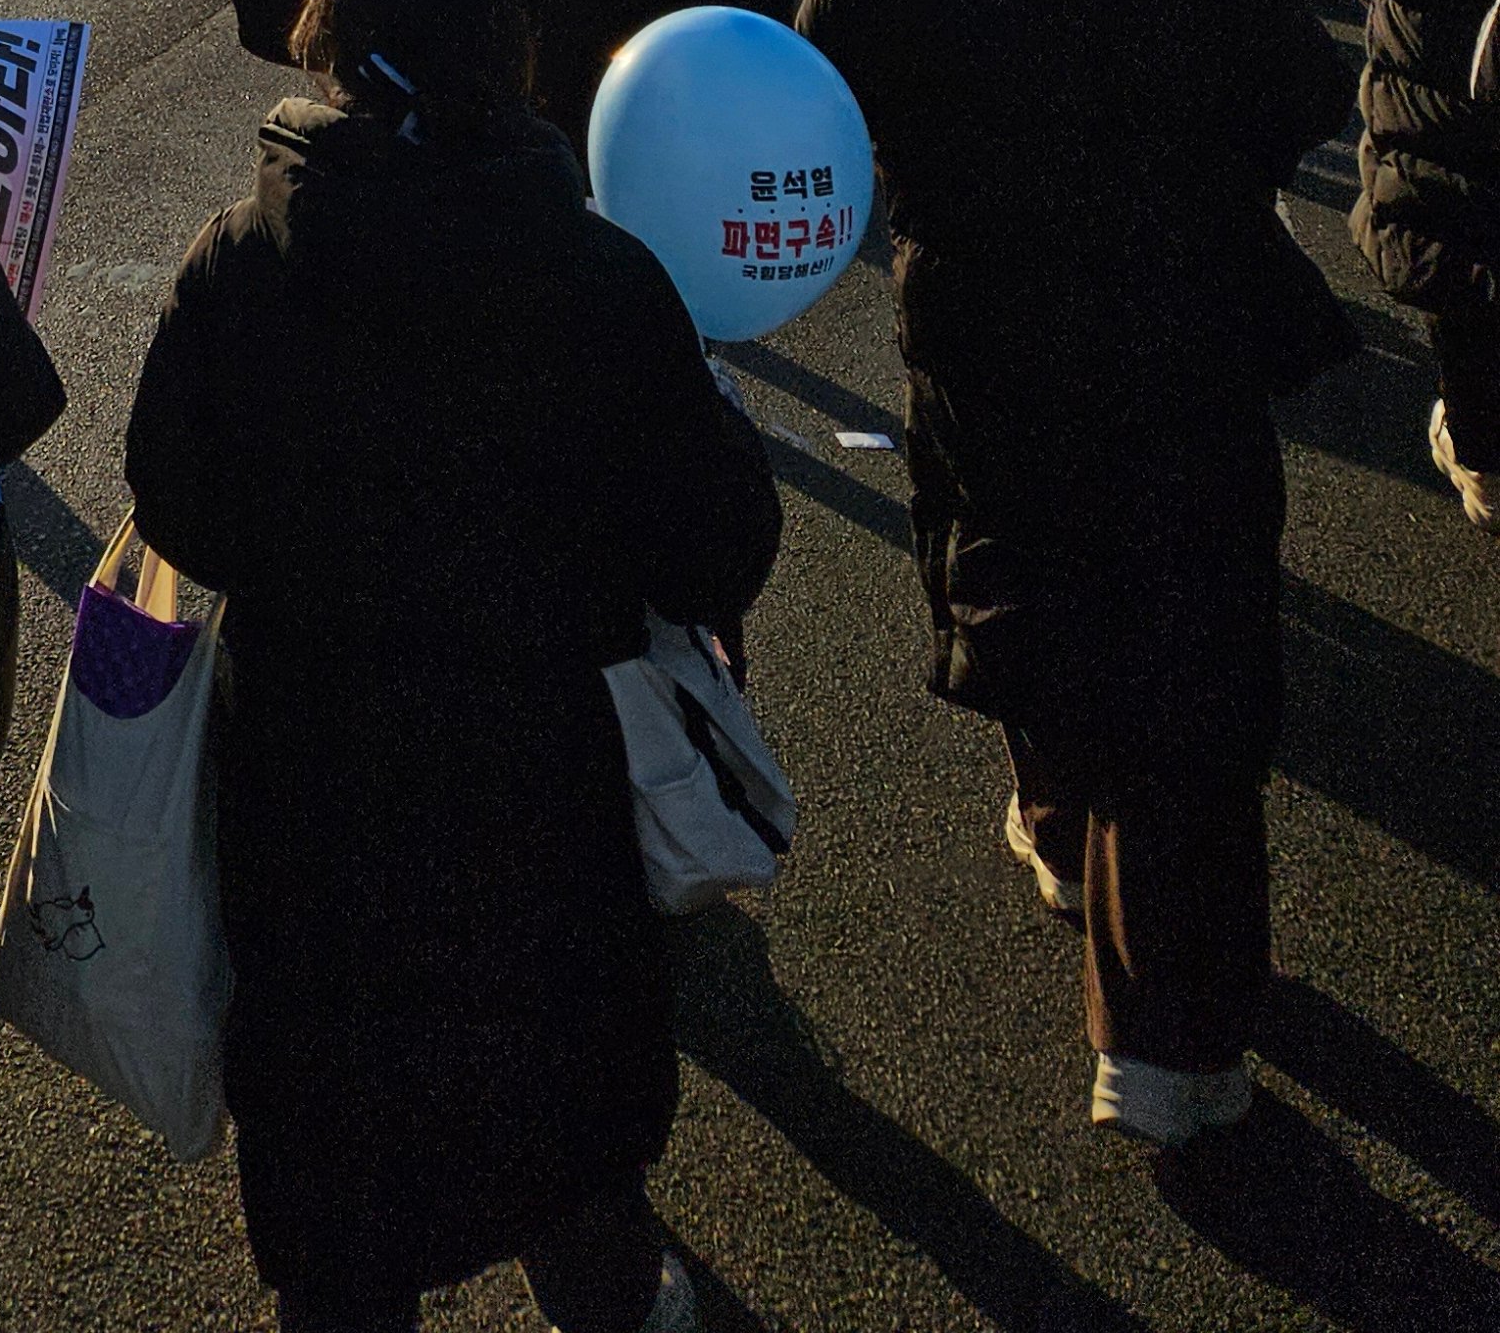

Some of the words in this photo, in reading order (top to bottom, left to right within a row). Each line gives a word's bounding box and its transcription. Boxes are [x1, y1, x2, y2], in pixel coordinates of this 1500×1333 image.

[751, 165, 834, 202] 윤석열
[721, 205, 853, 261] 파면구속!!
[742, 256, 835, 281] 국힘당해산!!
